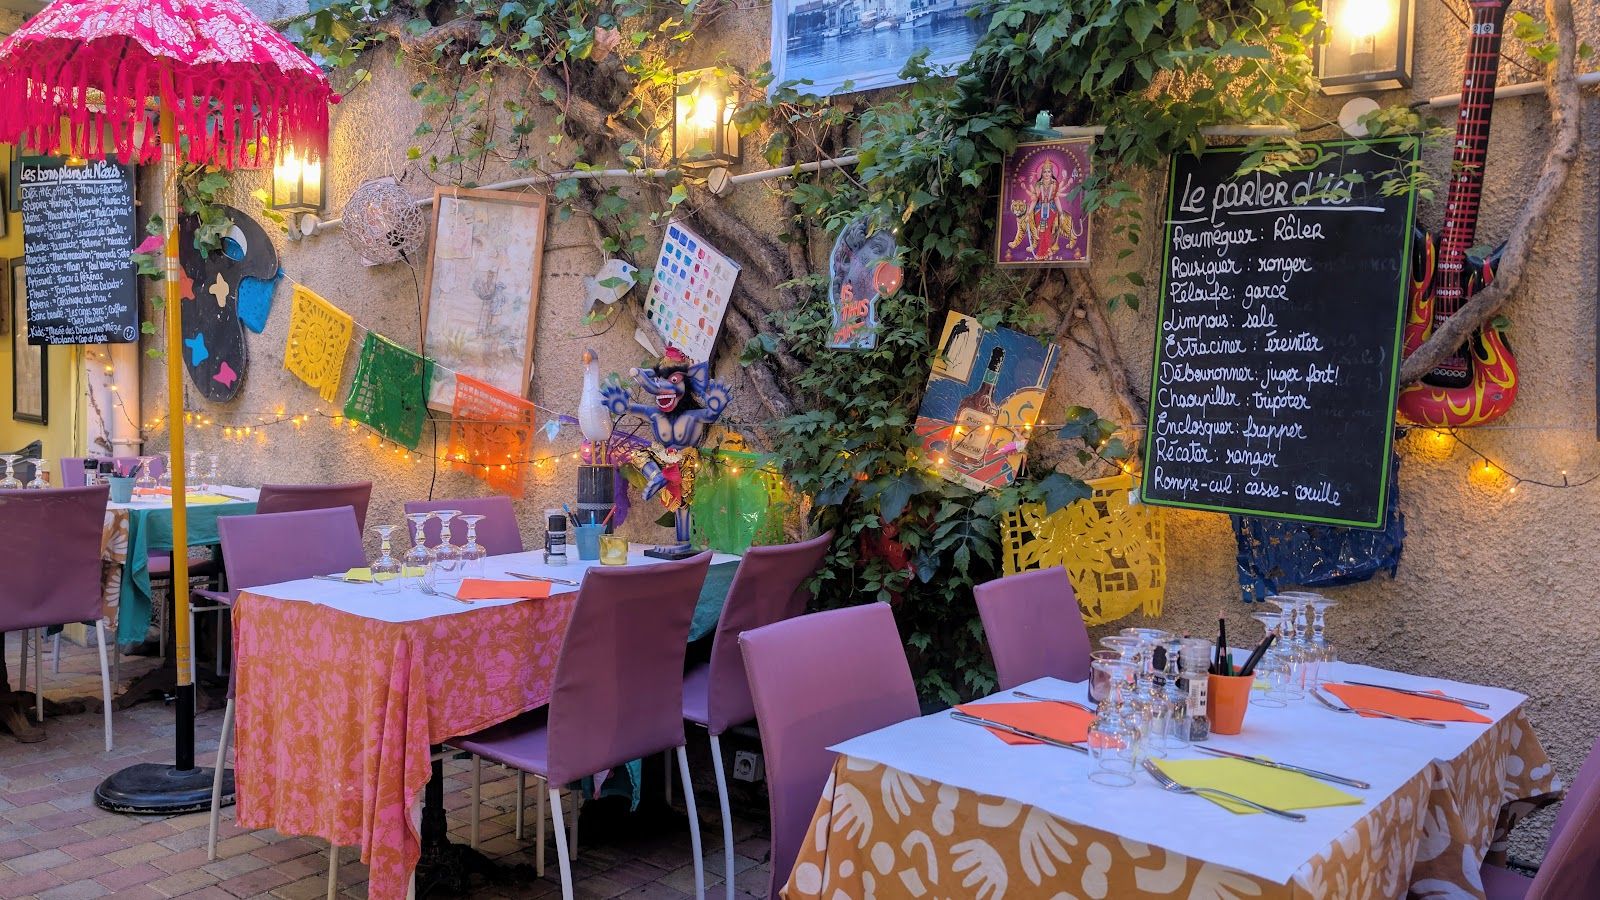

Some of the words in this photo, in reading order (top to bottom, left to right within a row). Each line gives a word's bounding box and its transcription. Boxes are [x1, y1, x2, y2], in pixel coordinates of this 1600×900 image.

[1179, 173, 1206, 212] Le
[1257, 256, 1312, 283] ronger
[1241, 283, 1290, 309] garce
[1242, 304, 1278, 333] sale
[1264, 330, 1324, 353] éreinter
[1260, 361, 1302, 393] juger
[1252, 391, 1311, 417] tripoter
[1242, 415, 1307, 450] frapper
[1225, 449, 1279, 476] ranger
